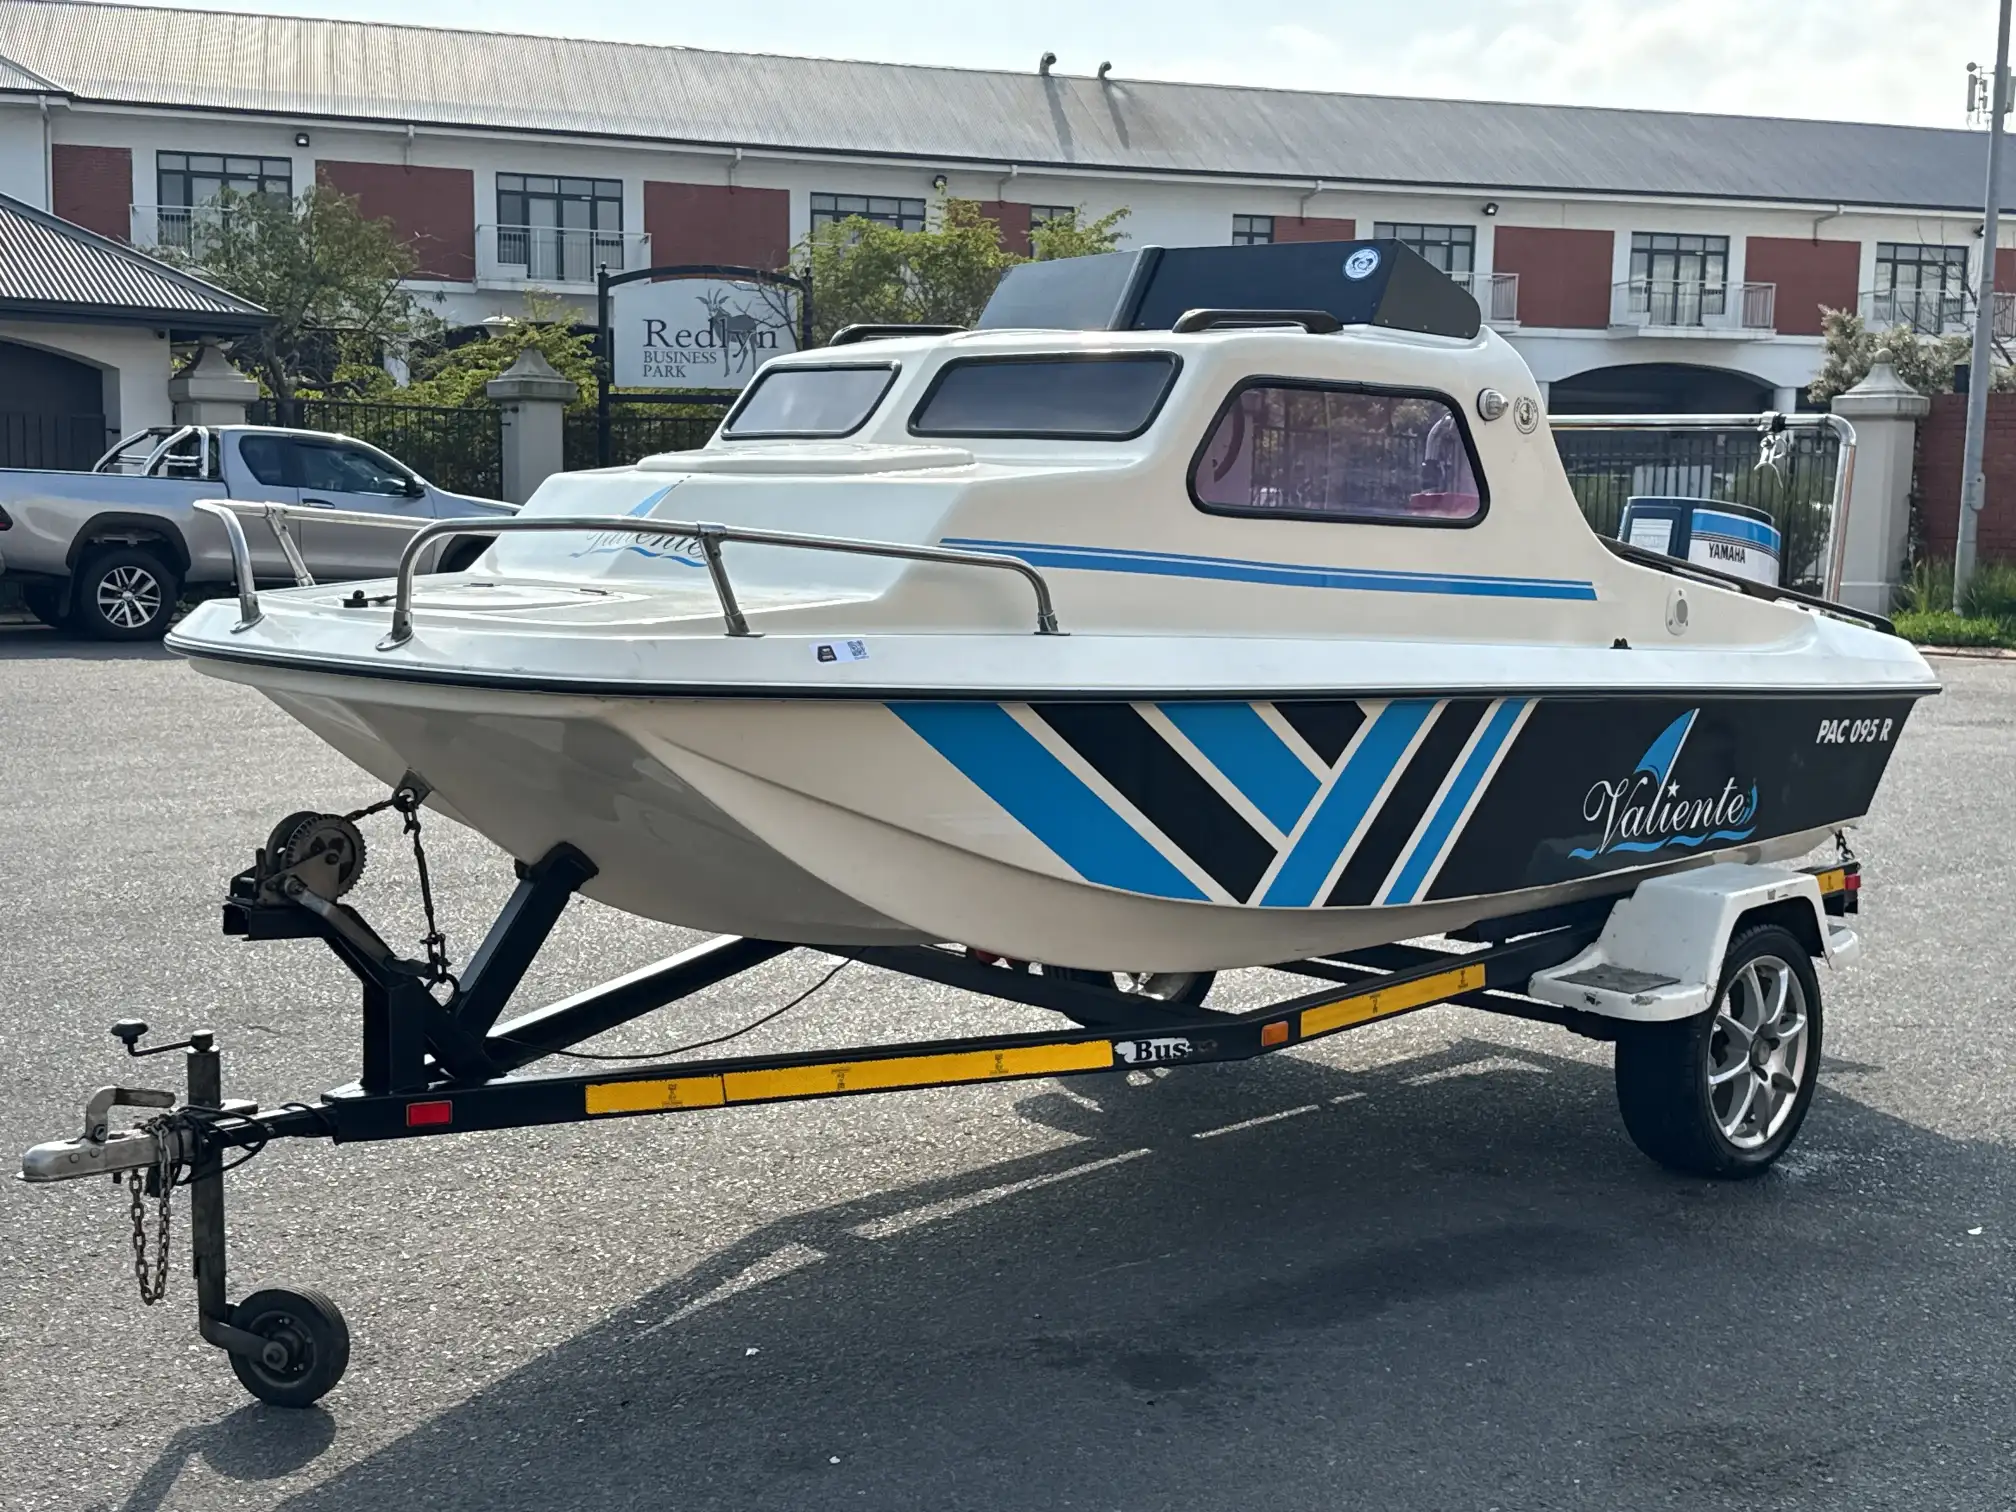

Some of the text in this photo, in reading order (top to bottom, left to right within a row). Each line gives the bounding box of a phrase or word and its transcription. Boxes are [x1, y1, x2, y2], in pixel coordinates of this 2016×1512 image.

[642, 318, 779, 358] Redlyn
[643, 351, 717, 364] BUSINESS
[643, 365, 687, 378] PARK
[1708, 542, 1746, 564] YAMAHA
[1815, 717, 1893, 744] PAC 095 R
[1583, 768, 1746, 854] Valiente
